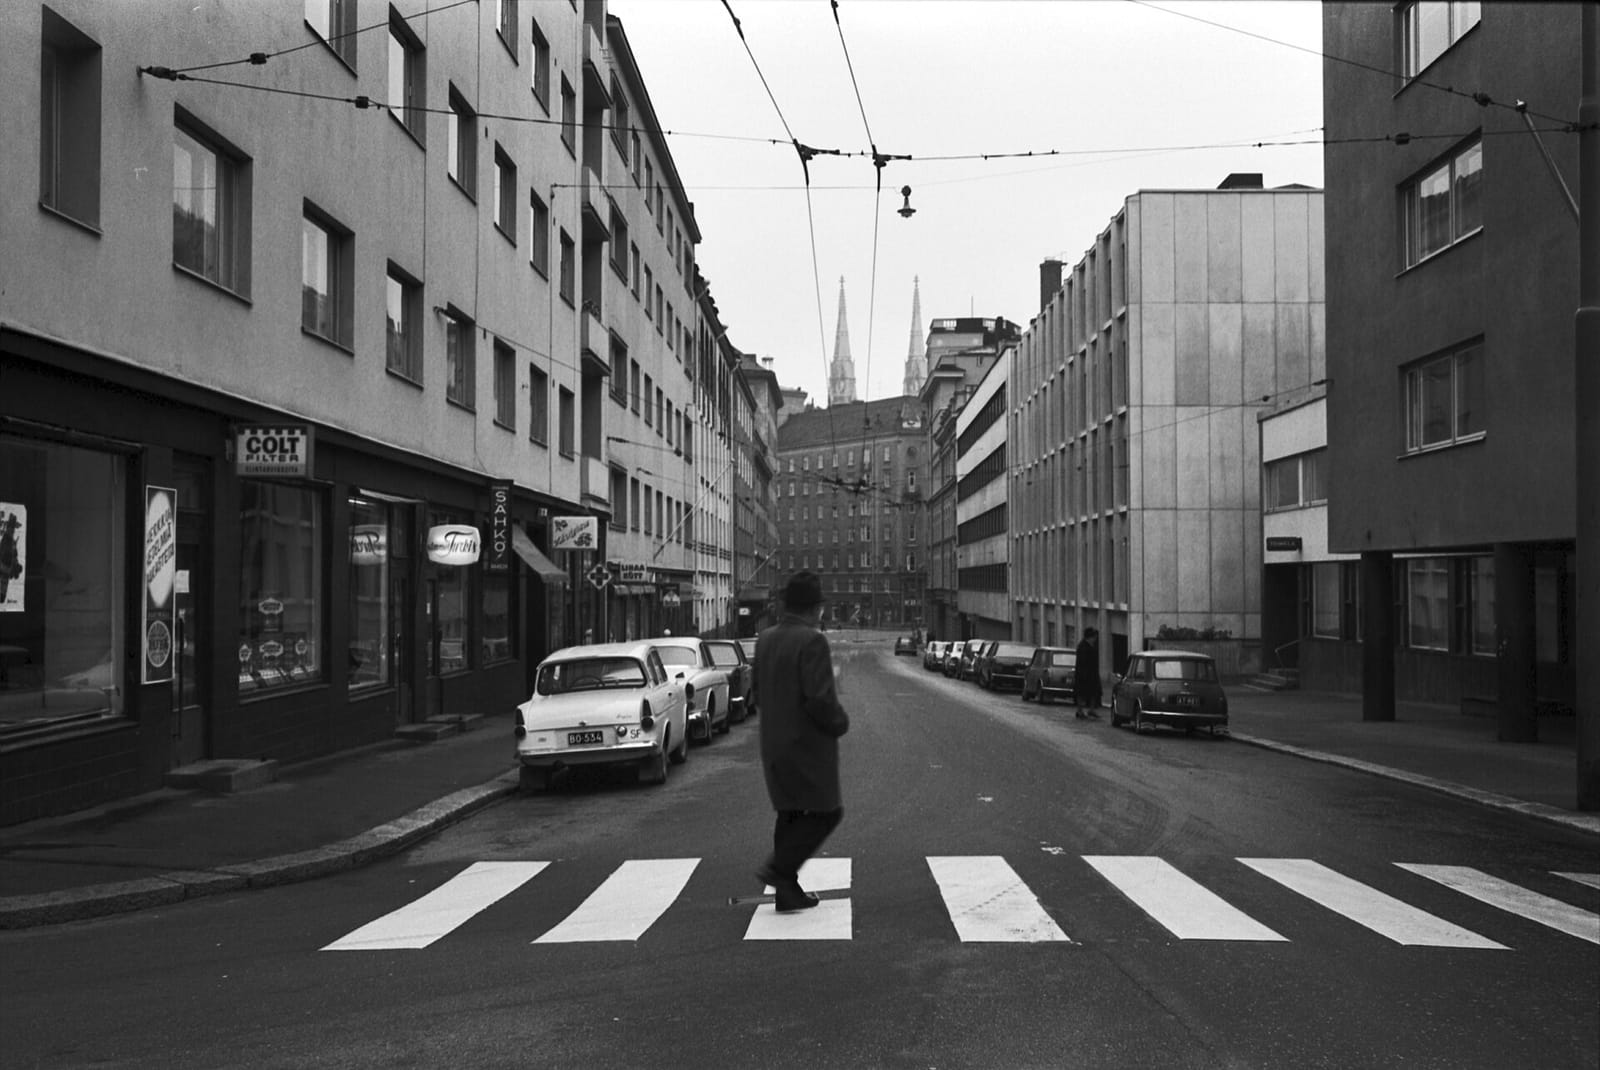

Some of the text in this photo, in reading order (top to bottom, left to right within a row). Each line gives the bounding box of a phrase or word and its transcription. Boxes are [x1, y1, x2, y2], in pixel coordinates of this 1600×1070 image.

[246, 436, 300, 454] COLT
[246, 454, 299, 462] FILTER
[494, 491, 507, 552] SÄHKÖ
[630, 728, 641, 739] SF
